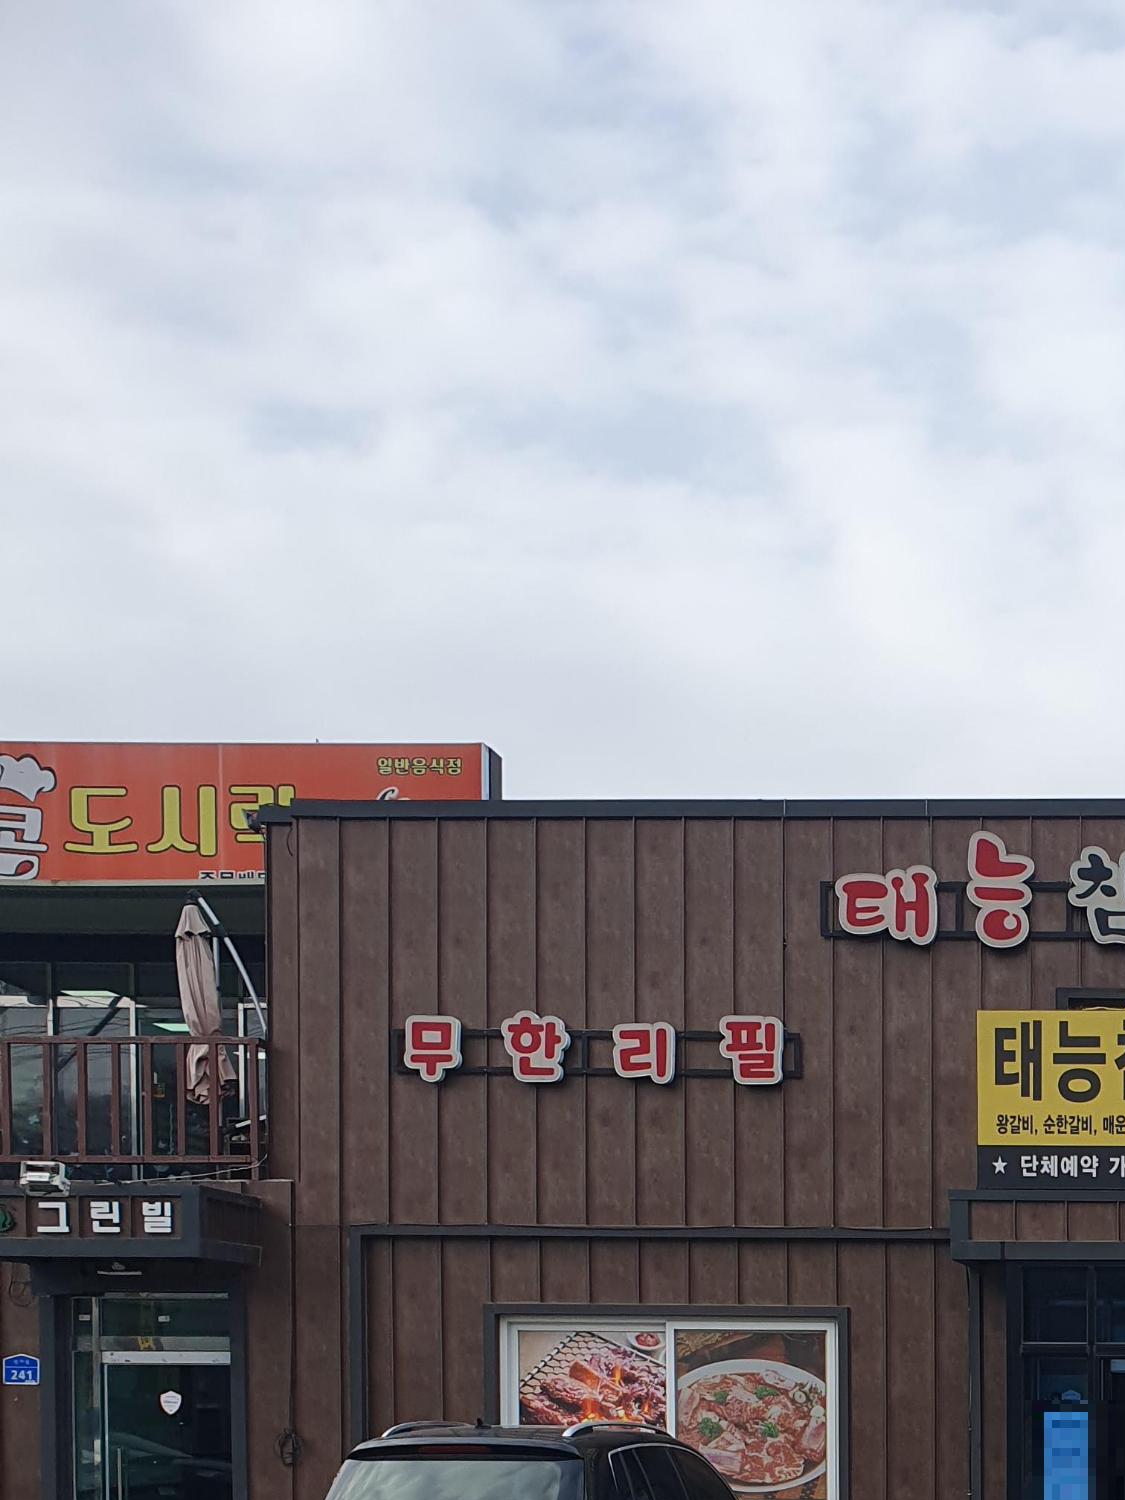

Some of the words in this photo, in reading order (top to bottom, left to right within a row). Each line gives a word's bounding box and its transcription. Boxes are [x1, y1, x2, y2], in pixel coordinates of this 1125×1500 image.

[377, 757, 462, 776] 일반음식점
[408, 1014, 778, 1080] 무한리필
[996, 1114, 1038, 1135] 왕갈비,
[1043, 1114, 1097, 1135] 순한갈비,
[1021, 1155, 1098, 1177] 단체예약
[36, 1201, 172, 1233] 그린빌
[11, 1370, 32, 1380] 241
